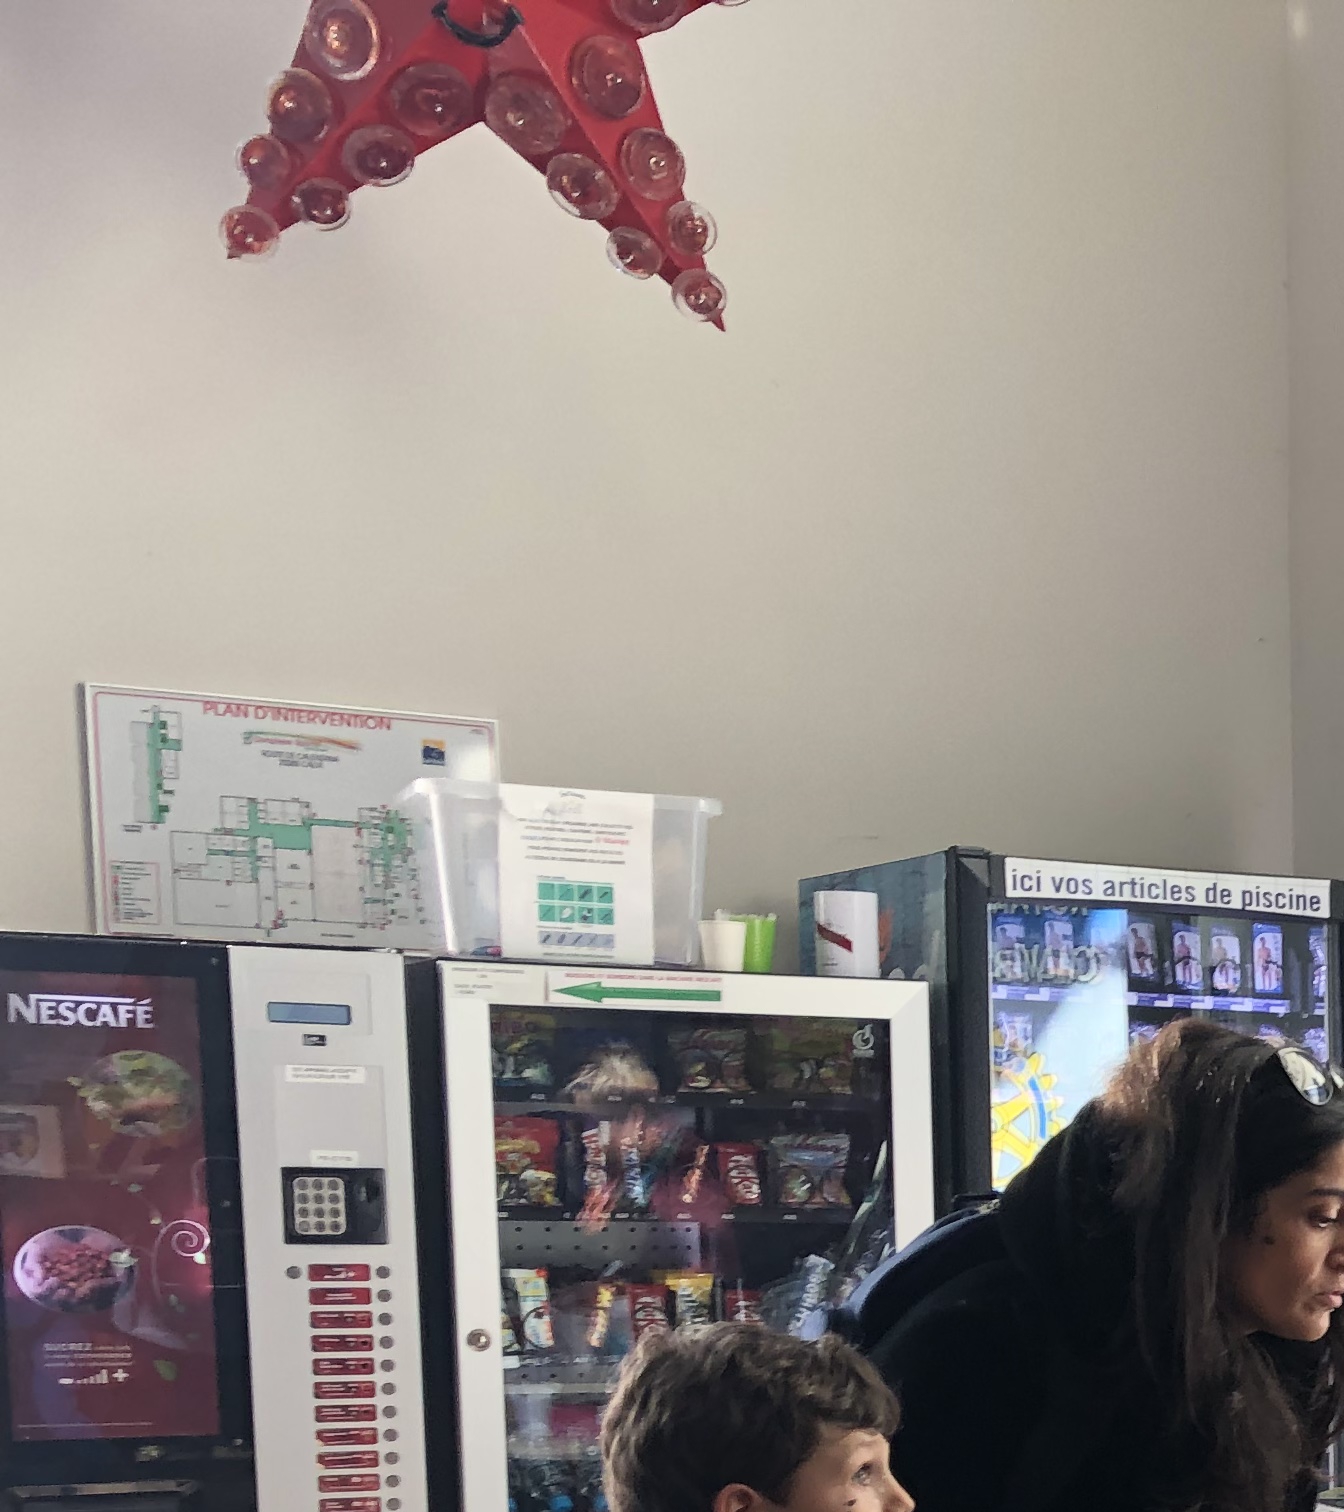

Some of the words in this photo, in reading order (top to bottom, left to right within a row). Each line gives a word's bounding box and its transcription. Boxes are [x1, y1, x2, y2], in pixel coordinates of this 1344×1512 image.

[203, 700, 249, 720] PLAN
[253, 704, 392, 731] D'INTERVENTION
[1010, 868, 1043, 893] ici
[1051, 874, 1094, 897] vos
[1102, 876, 1197, 905] articles
[1204, 881, 1232, 906] de
[1240, 886, 1322, 913] piscine
[6, 992, 156, 1030] NESCAFÉ
